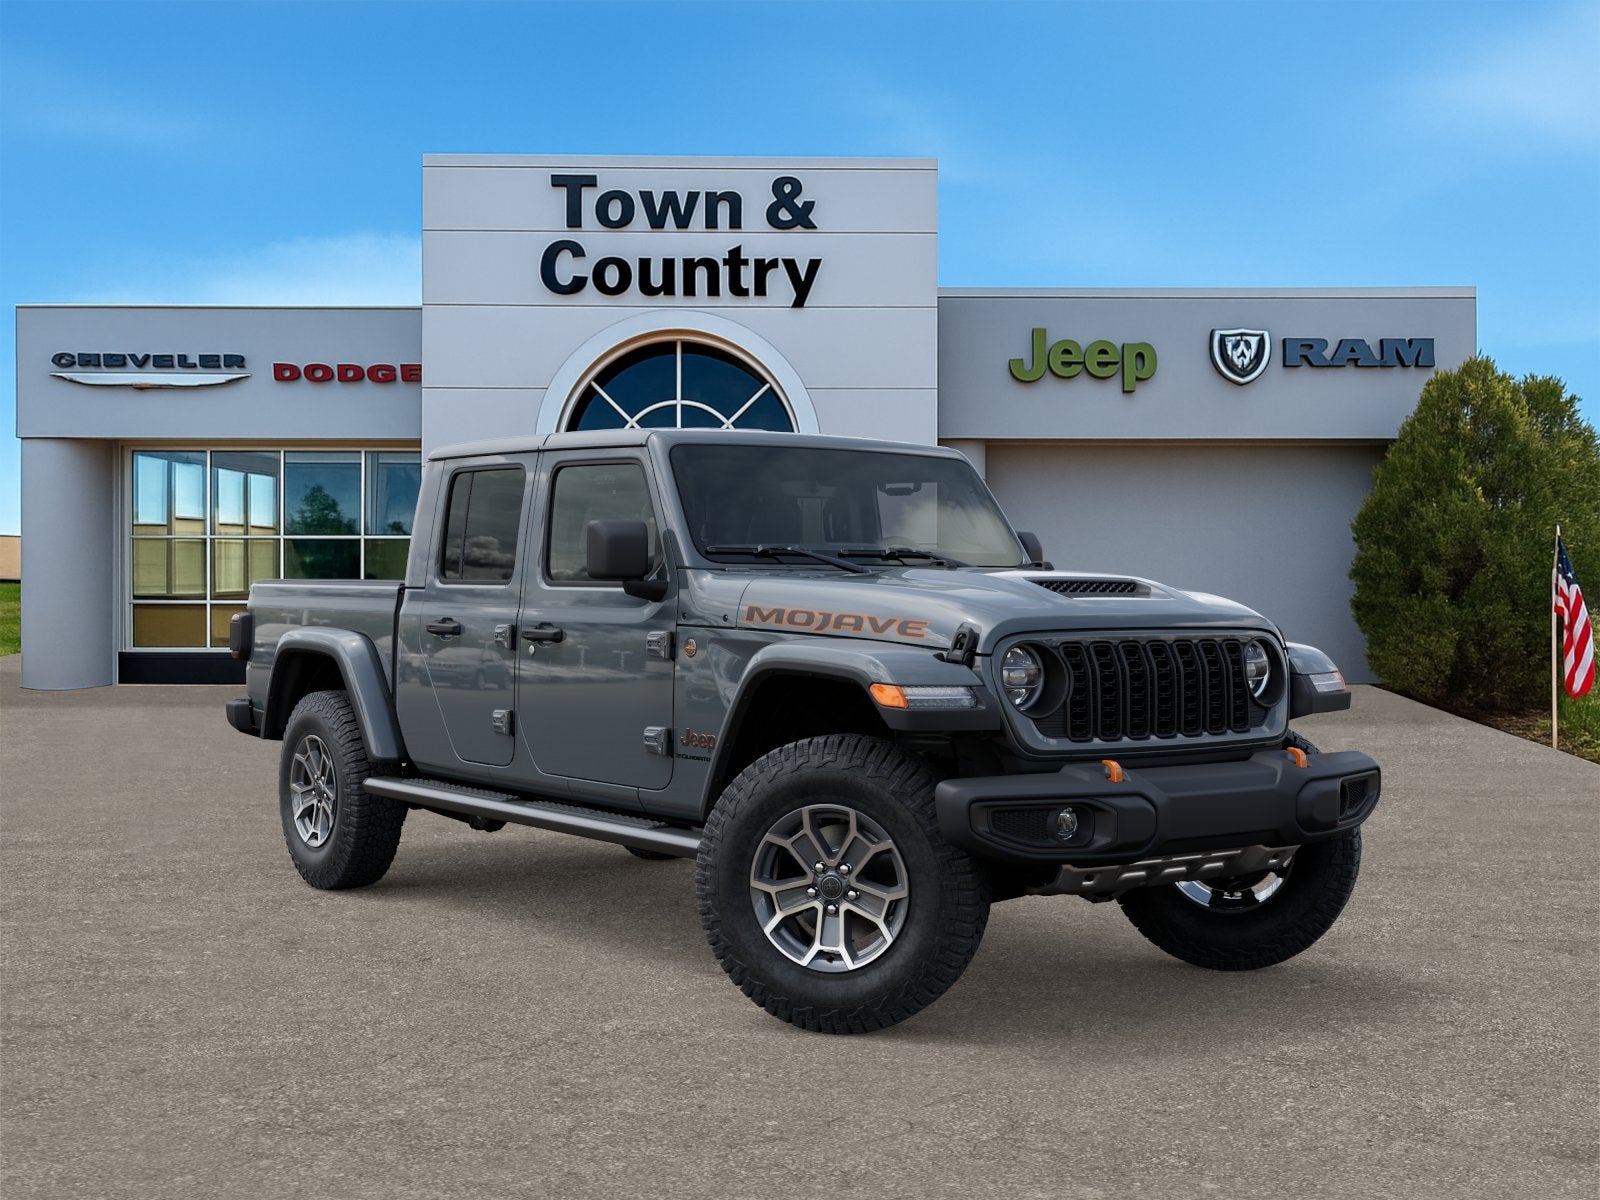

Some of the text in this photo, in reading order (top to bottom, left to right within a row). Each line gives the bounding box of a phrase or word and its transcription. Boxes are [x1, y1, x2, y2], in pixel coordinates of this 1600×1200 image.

[550, 174, 818, 229] Town &
[540, 239, 822, 308] Country
[1009, 327, 1158, 393] Jeep
[1282, 337, 1436, 368] RAM
[273, 362, 422, 383] DODGE
[743, 605, 929, 639] MOJAVE
[680, 727, 717, 753] Jeep
